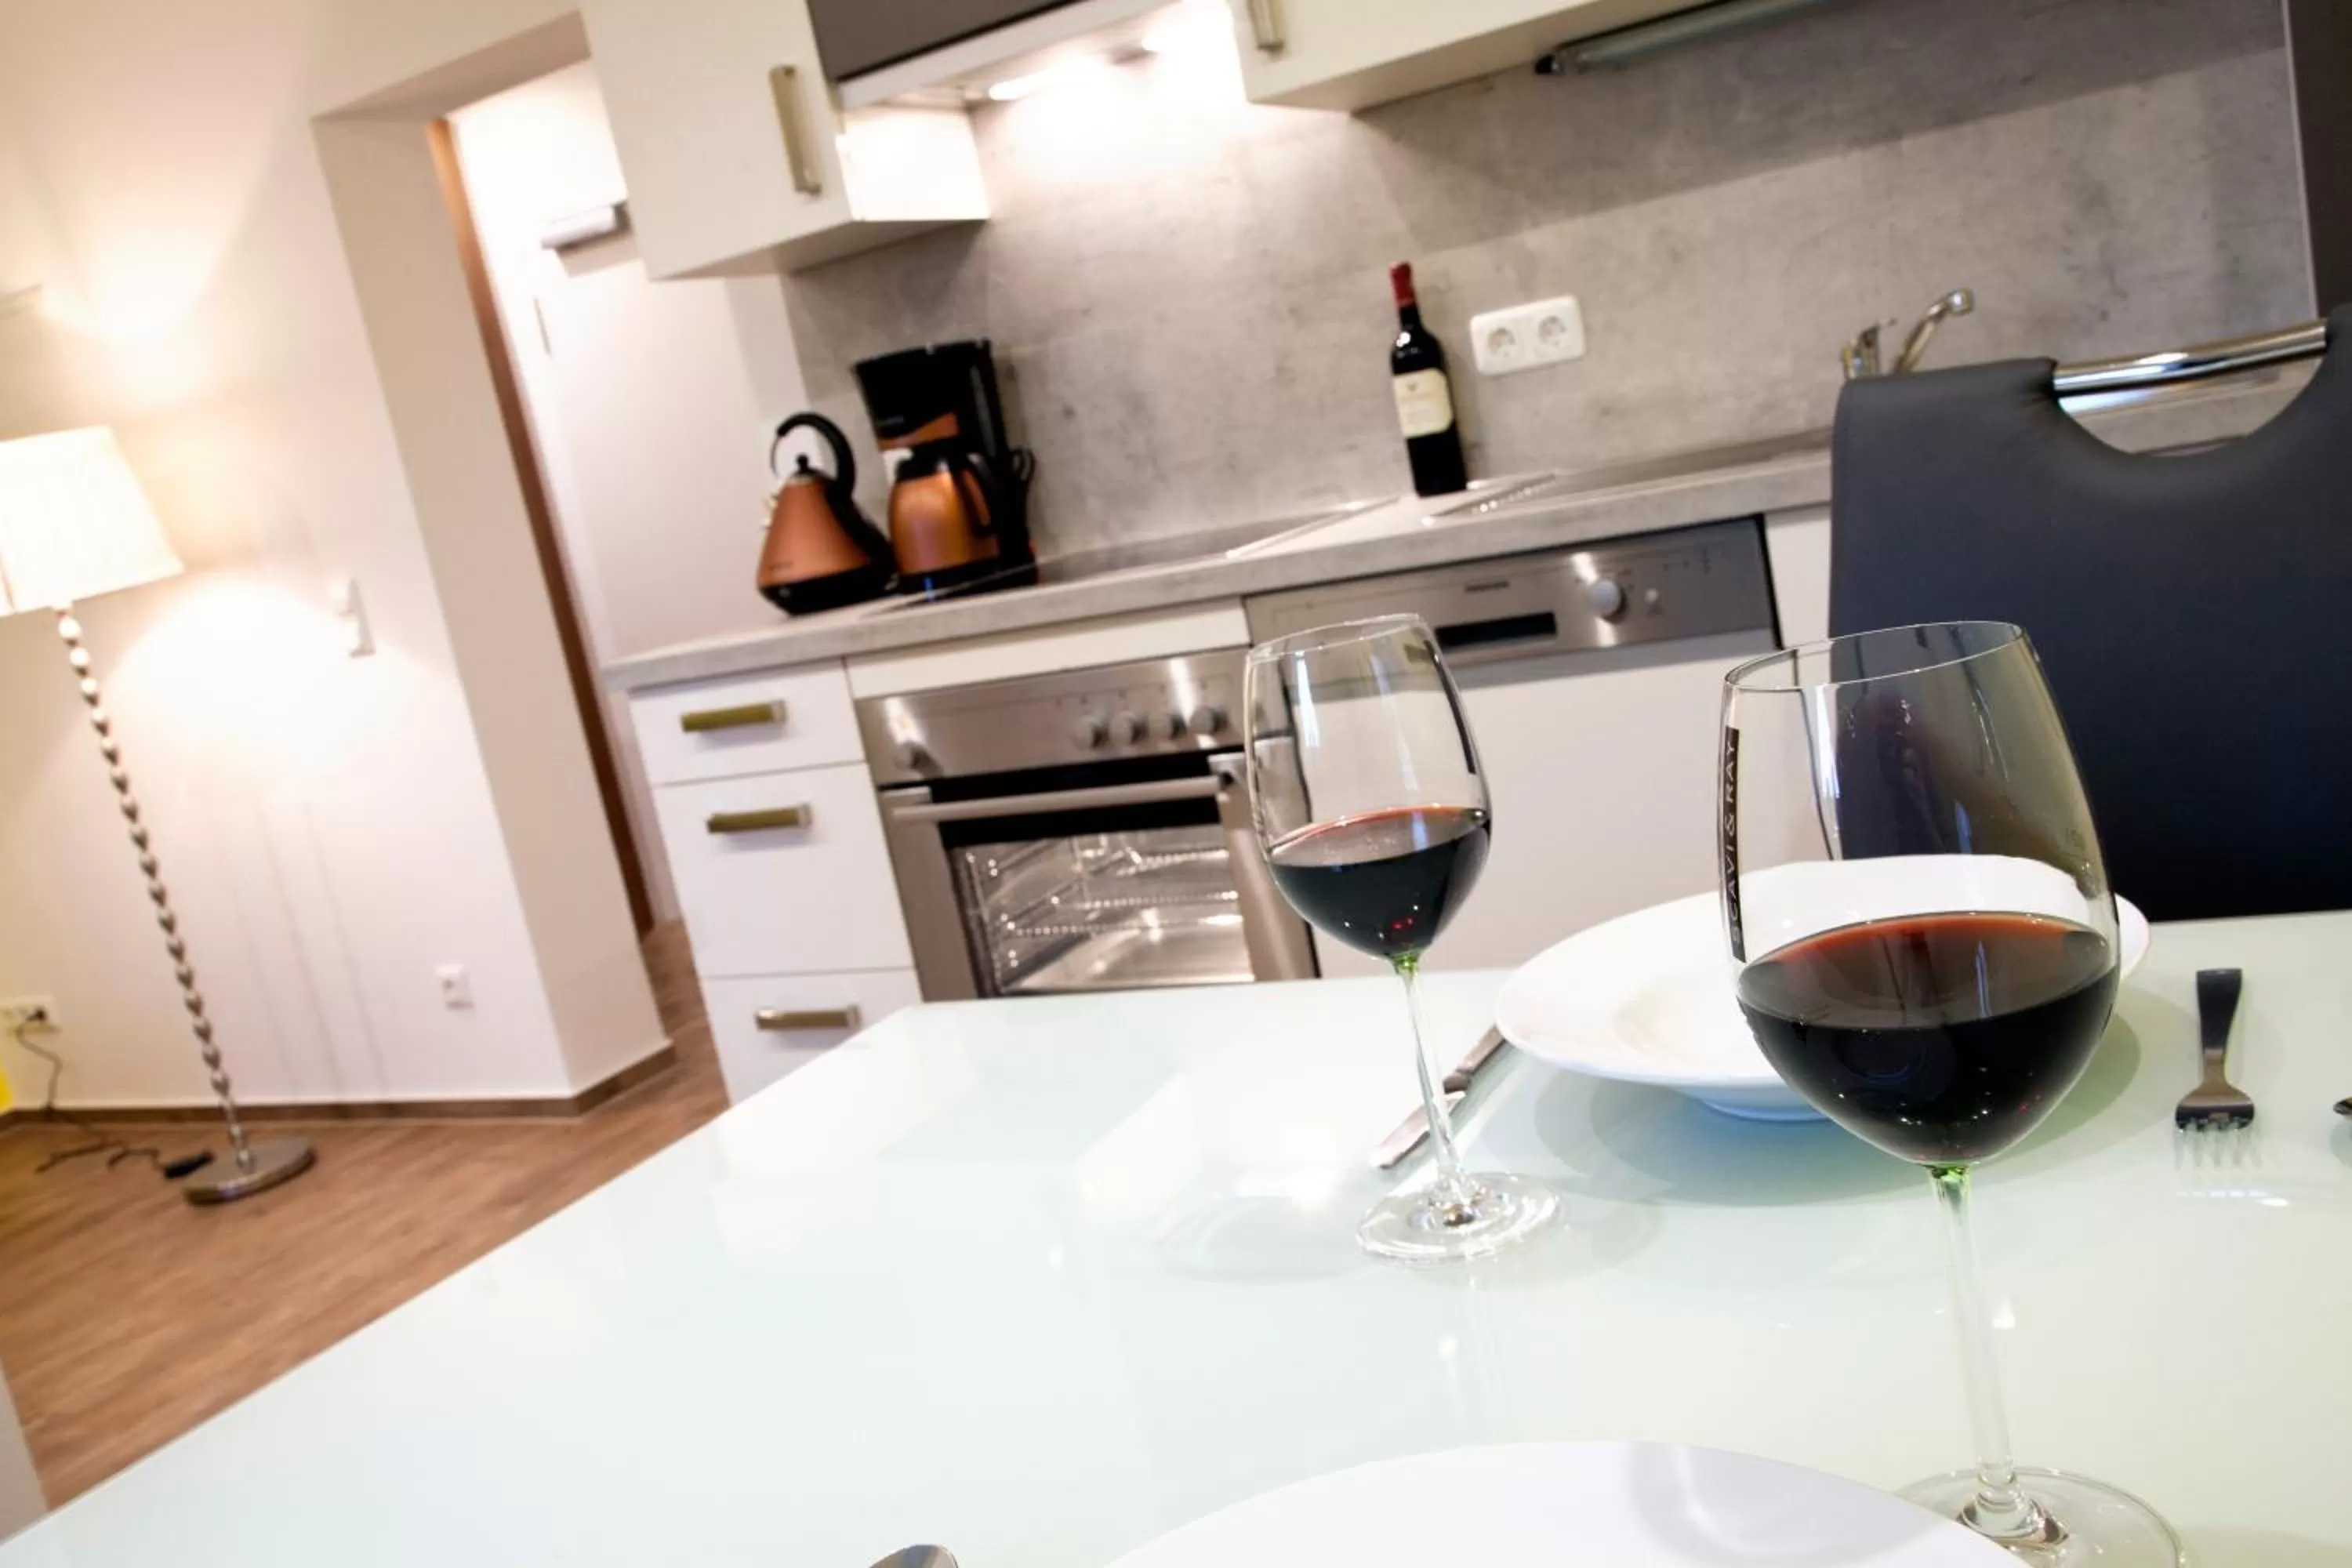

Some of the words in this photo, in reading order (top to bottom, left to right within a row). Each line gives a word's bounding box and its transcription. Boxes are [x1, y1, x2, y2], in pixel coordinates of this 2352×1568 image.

[1726, 741, 1735, 804] RAY
[1725, 813, 1735, 837] &
[1726, 844, 1740, 943] SCAVI
